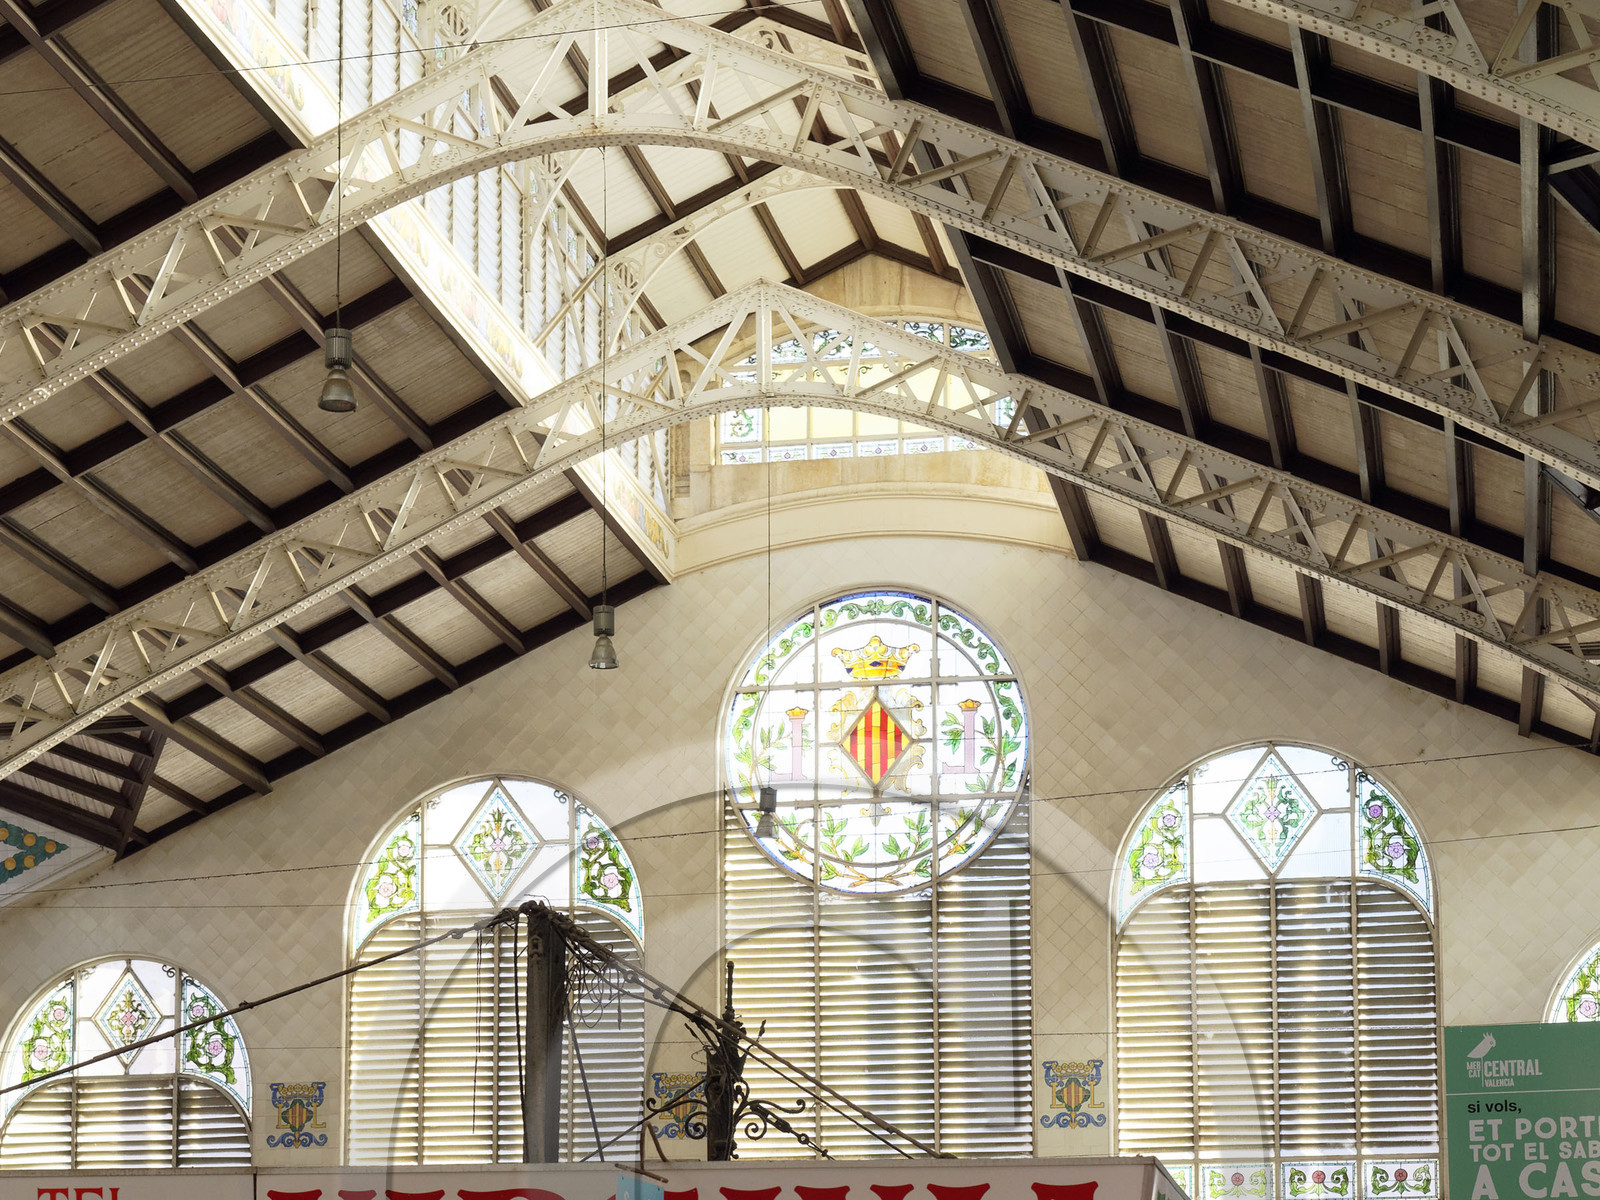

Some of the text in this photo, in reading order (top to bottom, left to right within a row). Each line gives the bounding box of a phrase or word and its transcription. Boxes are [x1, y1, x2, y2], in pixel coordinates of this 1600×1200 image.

[1466, 1061, 1481, 1070] MER
[1468, 1070, 1481, 1078] CAT
[1483, 1059, 1543, 1077] CENTRAL
[1467, 1099, 1522, 1114] si vols,
[1469, 1115, 1600, 1141] ET PORT
[1469, 1140, 1600, 1162] TOT EL SAB
[1471, 1160, 1600, 1200] A CAS
